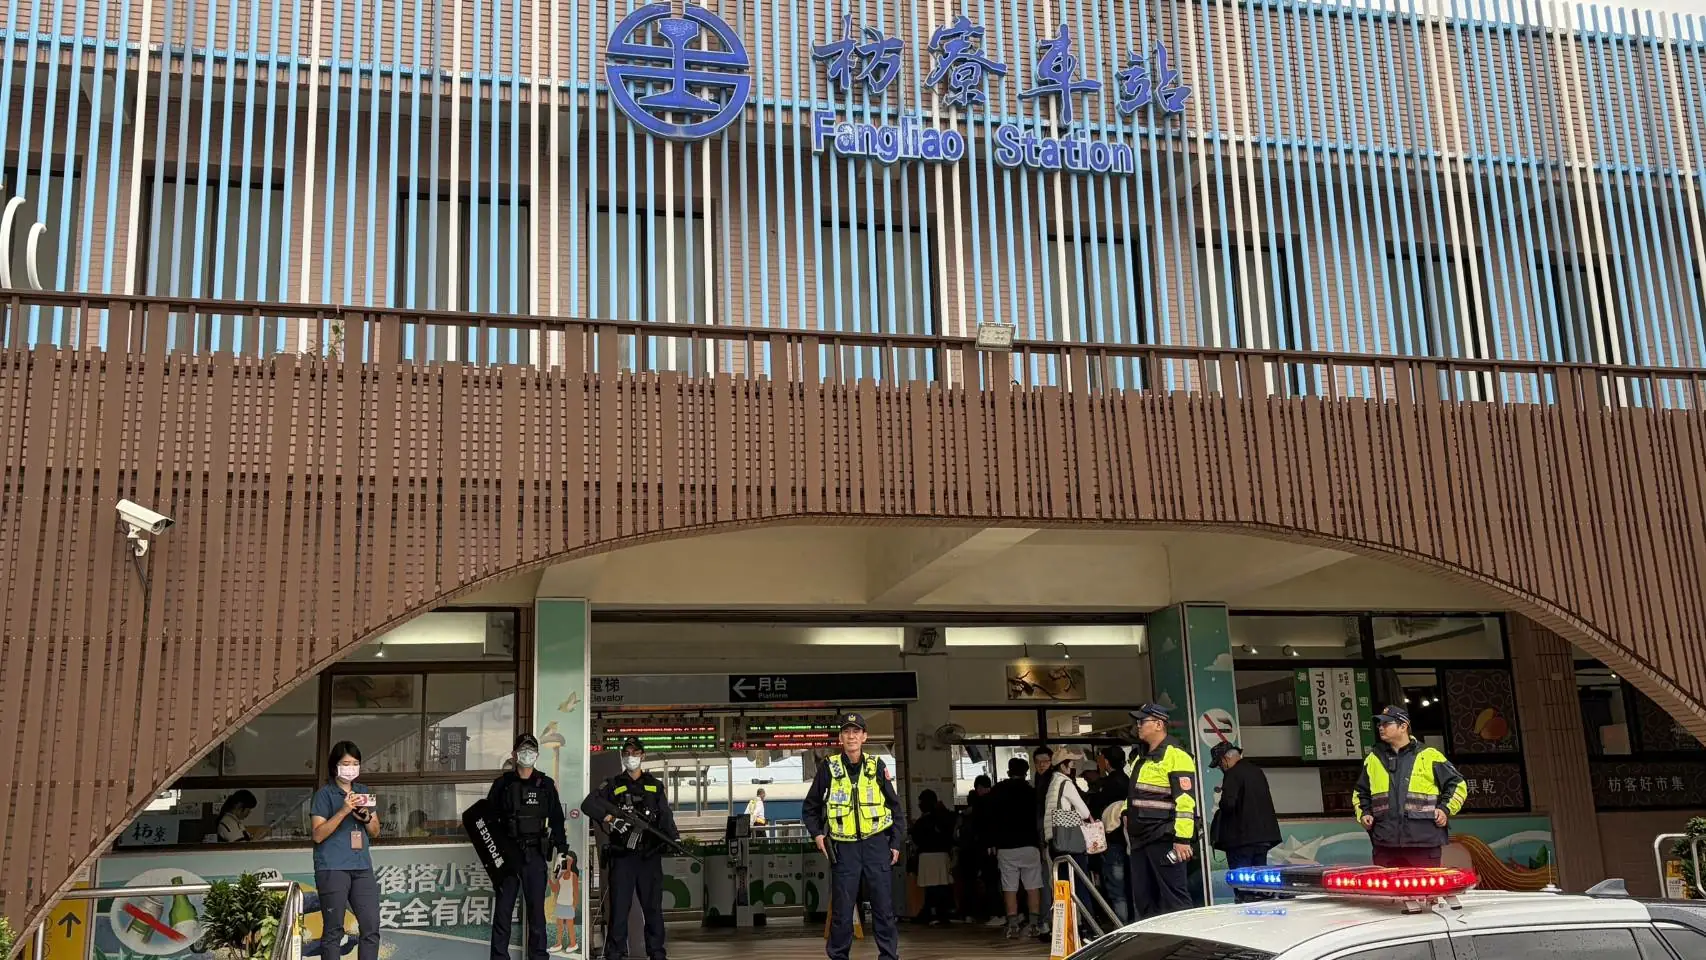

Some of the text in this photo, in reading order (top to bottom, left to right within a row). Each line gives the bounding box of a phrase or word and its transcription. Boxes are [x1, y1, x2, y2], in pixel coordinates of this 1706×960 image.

[812, 13, 1192, 125] 枋寮車站
[811, 108, 1135, 175] Fangliao Station
[591, 677, 620, 692] 電梯
[758, 677, 787, 691] 月台
[1315, 671, 1328, 715] TPASS
[1343, 712, 1356, 756] TPASS
[1466, 779, 1497, 794] 果乾
[1608, 776, 1684, 792] 枋客好市集
[253, 870, 278, 880] TAXI
